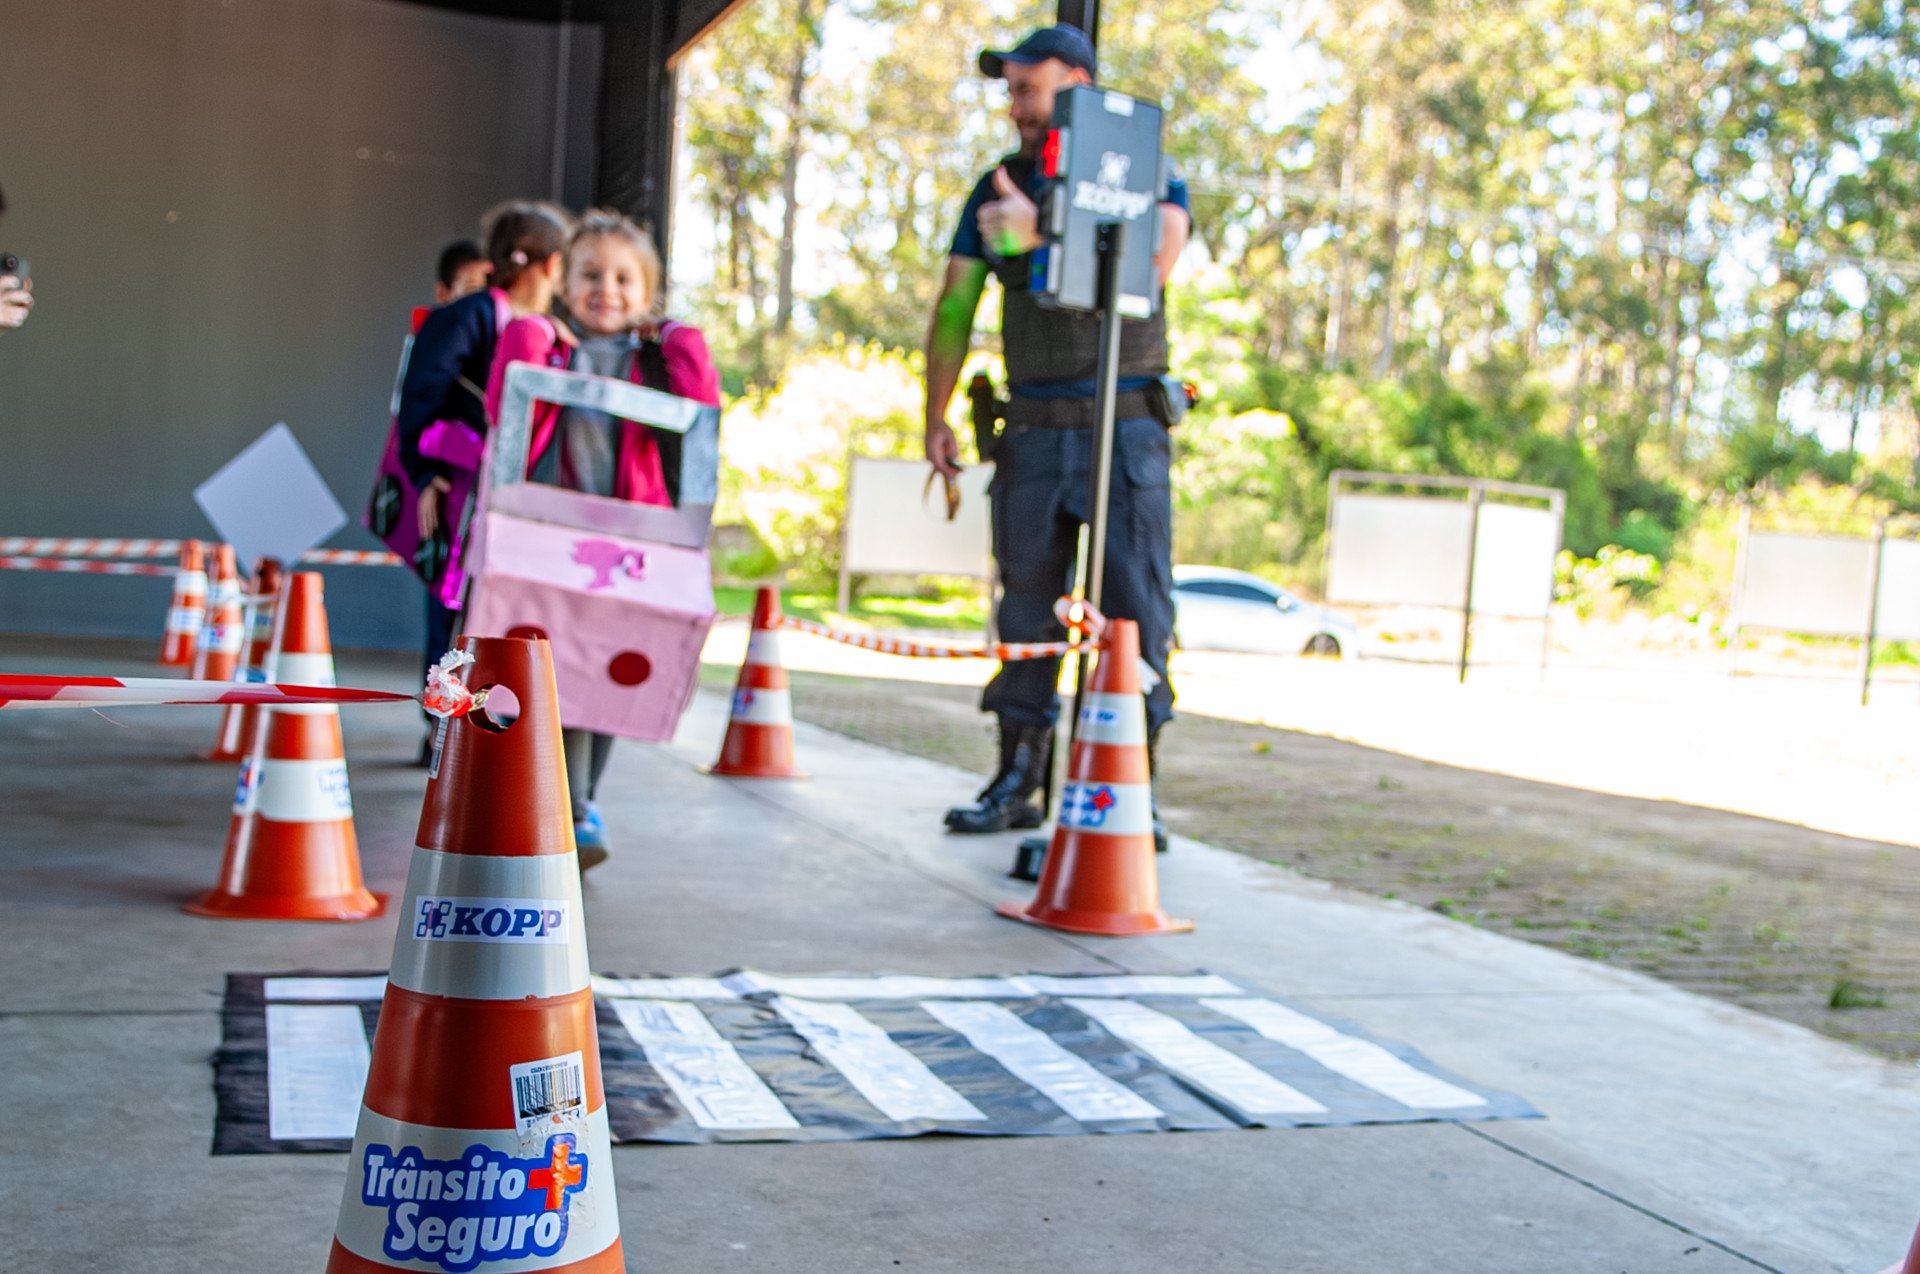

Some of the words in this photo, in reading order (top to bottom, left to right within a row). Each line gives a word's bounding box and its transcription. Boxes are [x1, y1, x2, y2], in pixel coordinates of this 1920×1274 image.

[449, 906, 563, 938] KOPP
[366, 1154, 526, 1201] Trânsito
[391, 1203, 561, 1266] Seguro
